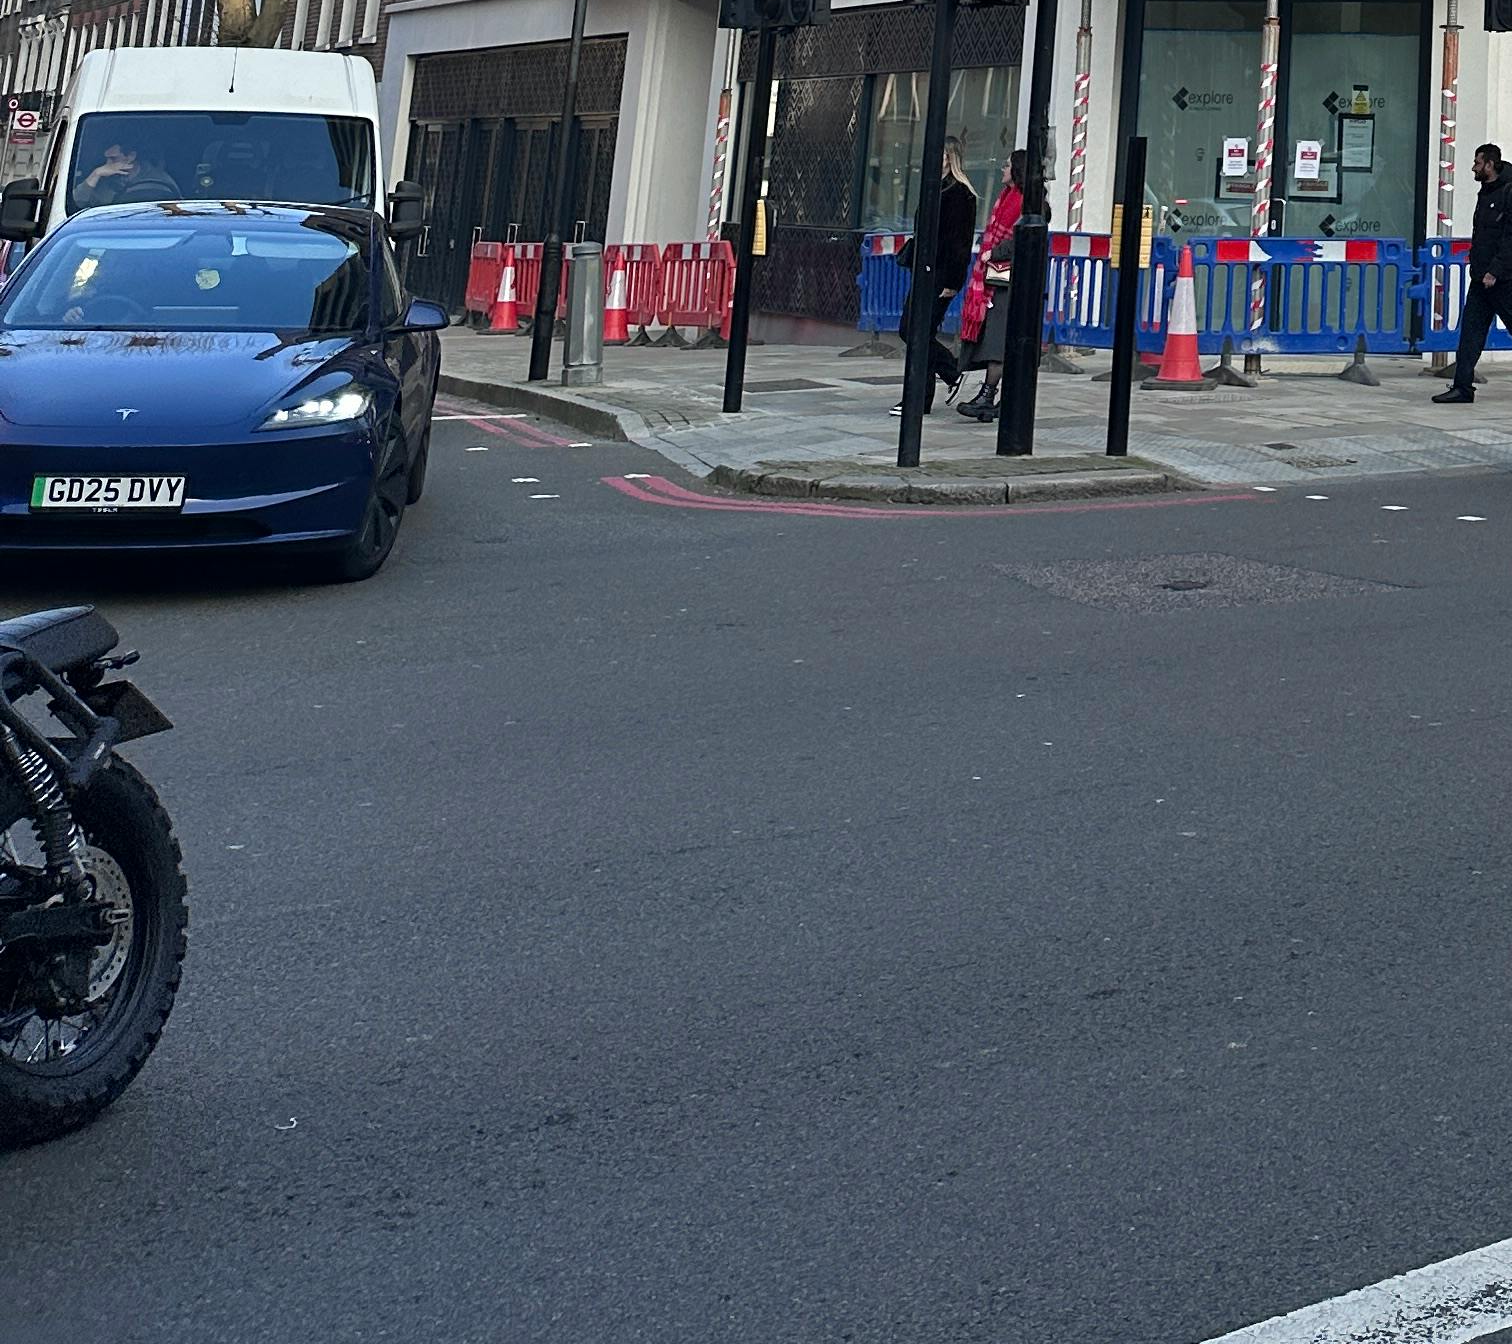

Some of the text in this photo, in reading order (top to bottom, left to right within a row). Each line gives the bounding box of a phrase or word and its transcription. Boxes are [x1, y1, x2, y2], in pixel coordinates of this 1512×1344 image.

[1188, 90, 1234, 105] explore
[1338, 96, 1386, 109] exore
[1181, 212, 1228, 227] explore
[1335, 218, 1381, 234] explore
[48, 478, 182, 503] GD25 DVY
